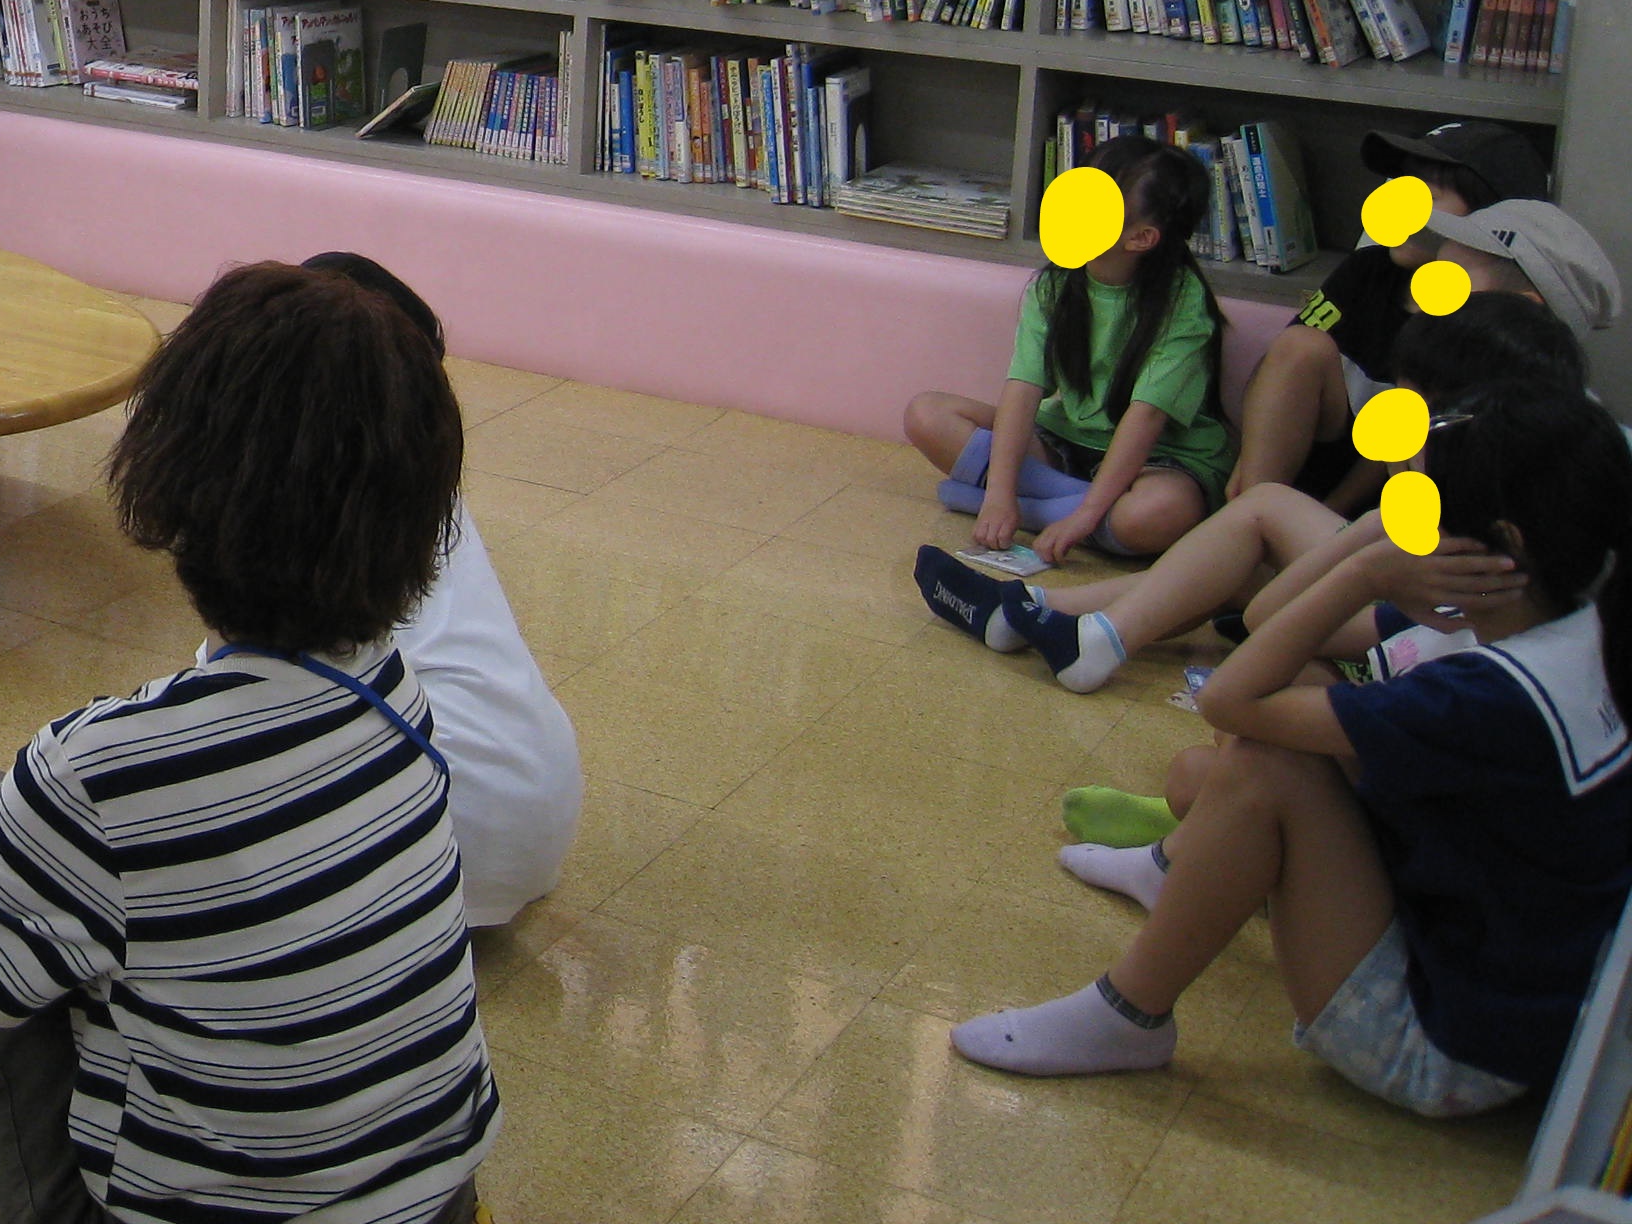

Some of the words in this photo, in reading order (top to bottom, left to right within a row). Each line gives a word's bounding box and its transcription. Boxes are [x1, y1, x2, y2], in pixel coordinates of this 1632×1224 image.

[79, 7, 111, 22] おうち
[80, 22, 113, 35] あそび
[87, 35, 113, 51] 大全
